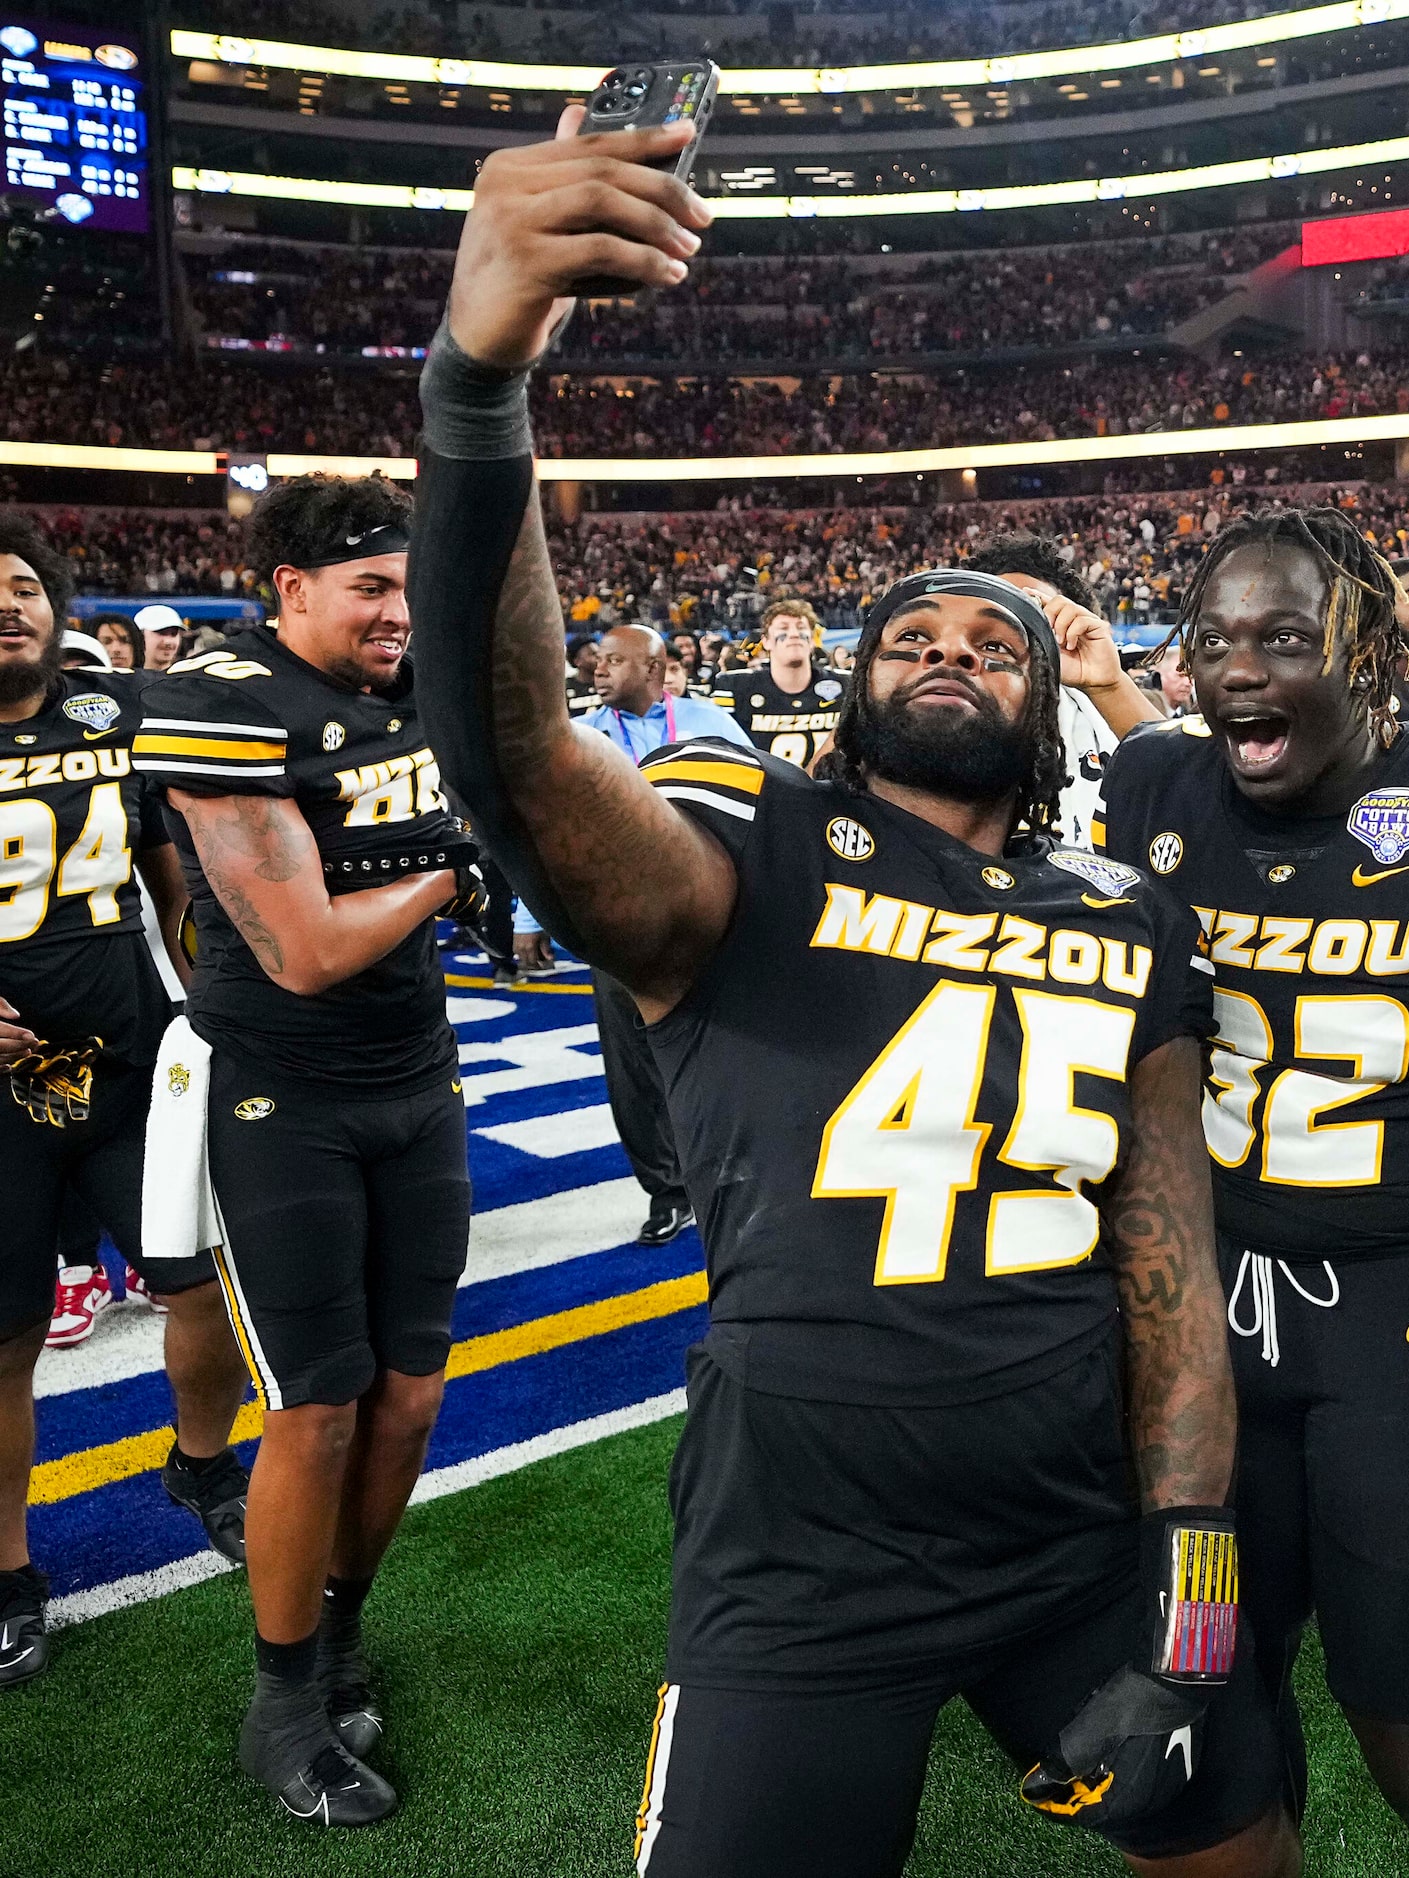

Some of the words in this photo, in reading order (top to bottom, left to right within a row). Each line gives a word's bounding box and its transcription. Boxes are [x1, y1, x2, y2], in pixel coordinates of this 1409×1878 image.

[0, 781, 132, 943] 94
[827, 820, 873, 859] SEC
[1152, 834, 1182, 872] SEC
[810, 883, 1153, 998] MIZZOU
[811, 978, 1136, 1287] 45
